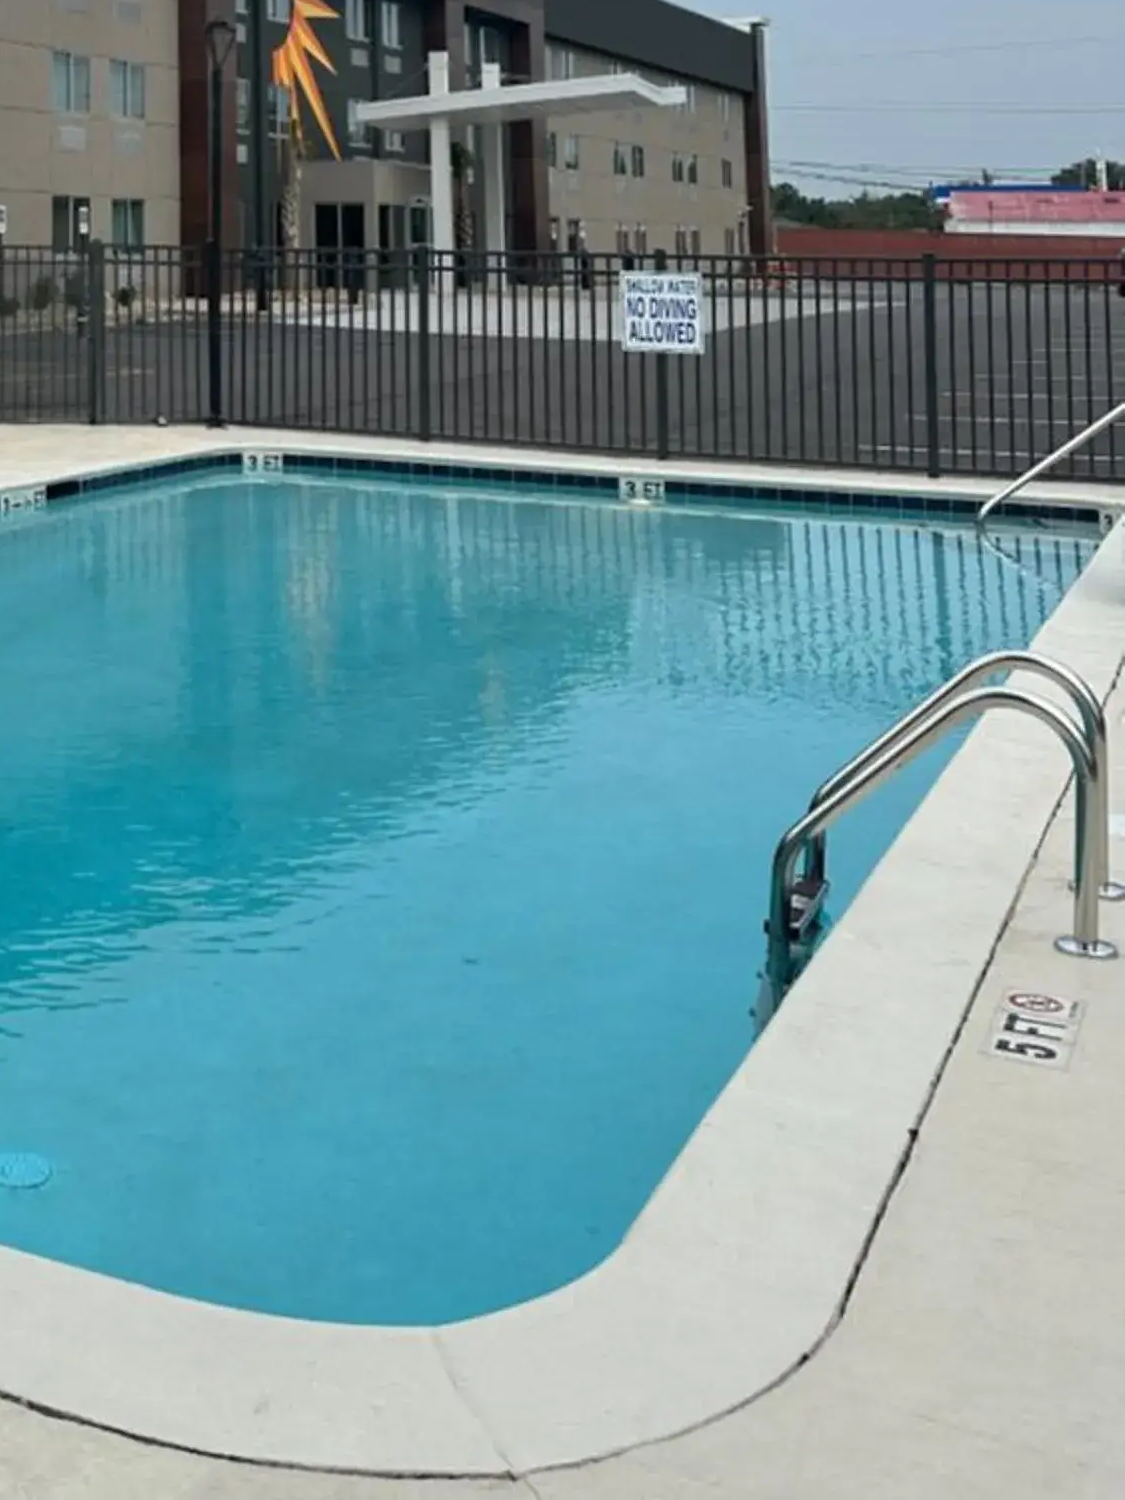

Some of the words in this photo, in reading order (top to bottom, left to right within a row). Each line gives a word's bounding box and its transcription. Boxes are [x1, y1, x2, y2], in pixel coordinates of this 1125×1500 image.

[626, 296, 645, 318] NO
[649, 297, 697, 320] DIVING
[629, 320, 696, 344] ALLOWED
[625, 481, 636, 499] 3
[642, 481, 661, 500] FT
[1002, 1012, 1069, 1041] FT
[994, 1038, 1058, 1060] 5
